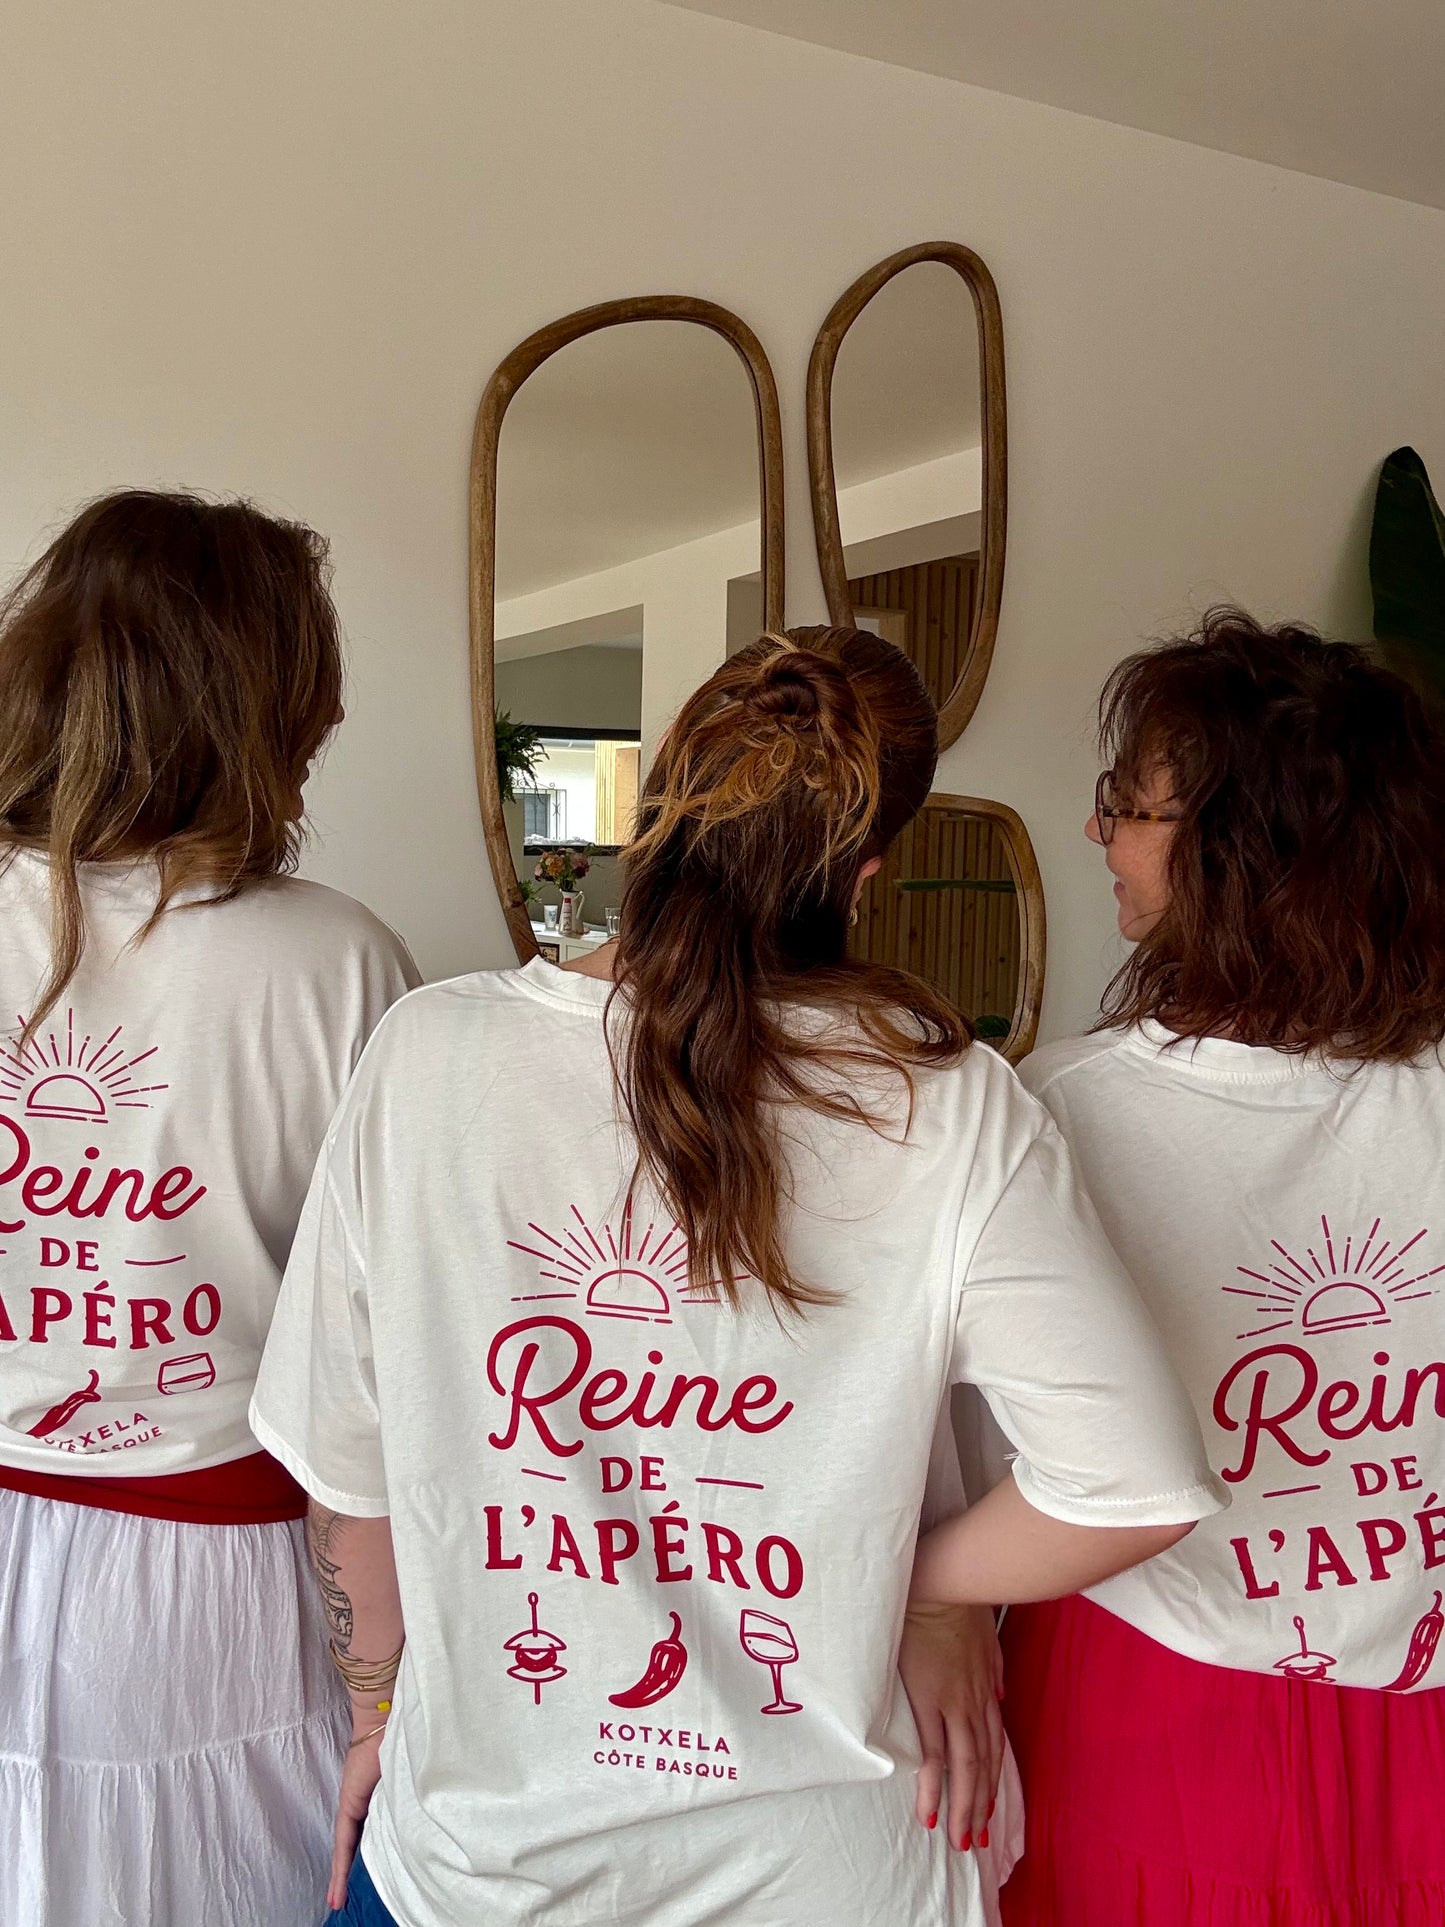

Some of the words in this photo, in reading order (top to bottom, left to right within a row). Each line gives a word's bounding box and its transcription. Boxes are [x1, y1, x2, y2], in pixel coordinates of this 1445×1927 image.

[39, 1236, 100, 1273] DE
[485, 1314, 795, 1459] Reine
[77, 1412, 149, 1448] XELA
[599, 1455, 668, 1494] DE
[1350, 1454, 1424, 1497] DE
[483, 1499, 805, 1600] L’APÉRO
[599, 1722, 731, 1755] KOTXELA
[593, 1749, 645, 1769] CÔTE
[656, 1757, 738, 1781] BASQUE
